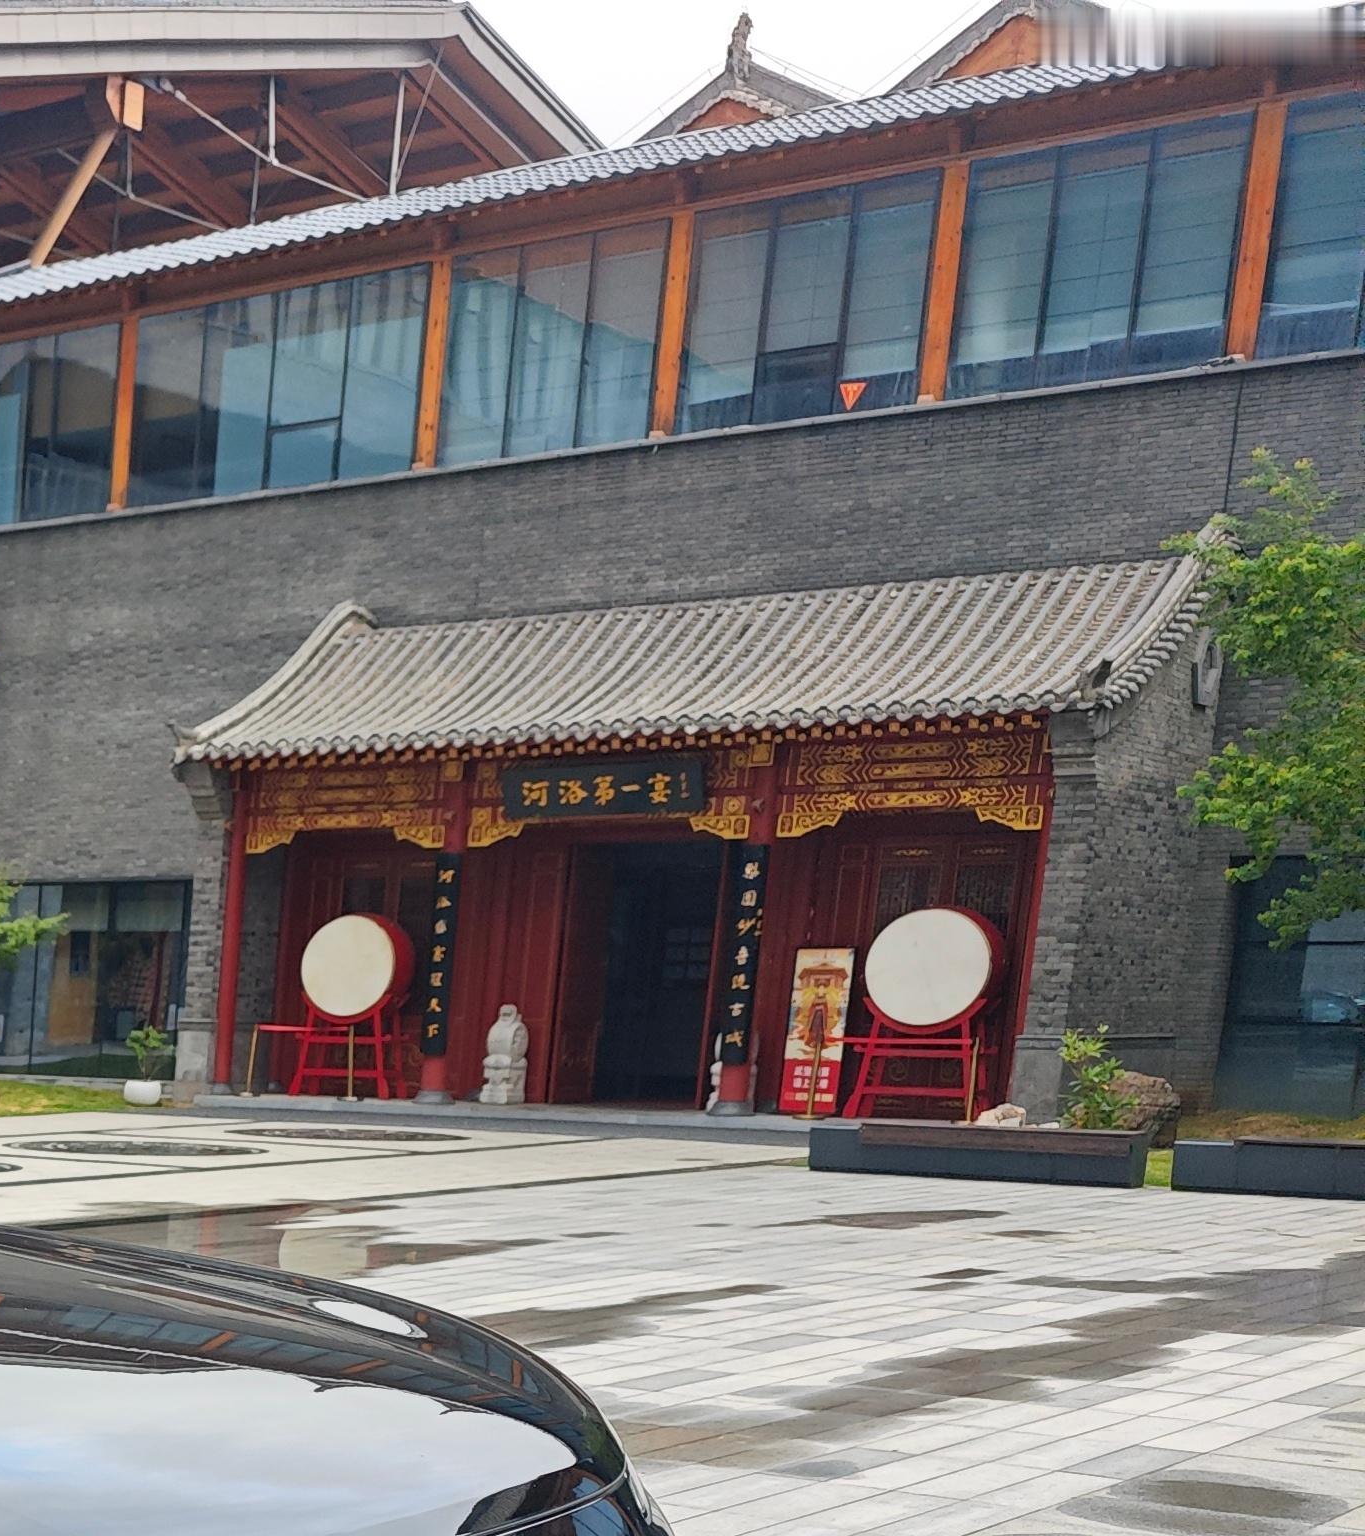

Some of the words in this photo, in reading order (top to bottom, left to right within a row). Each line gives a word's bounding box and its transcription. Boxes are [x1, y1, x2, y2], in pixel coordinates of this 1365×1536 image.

[521, 773, 672, 808] 河洛第一宴
